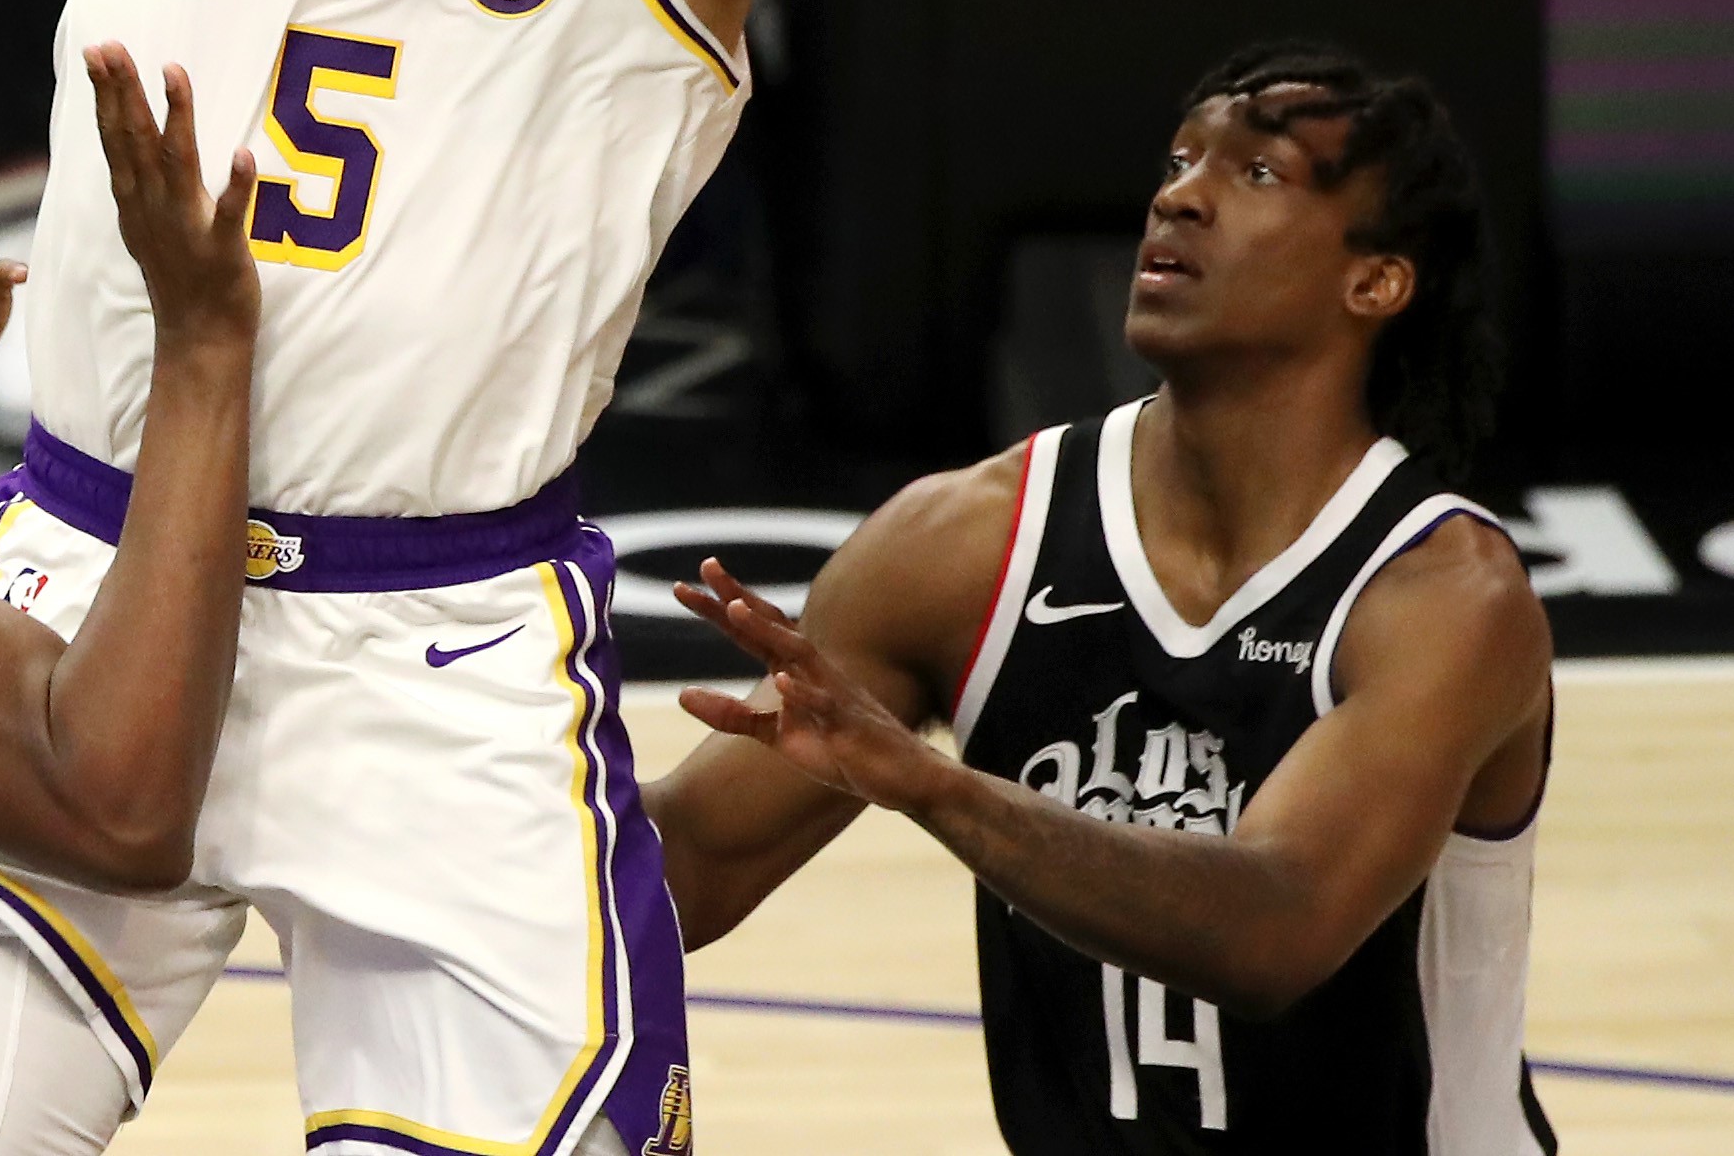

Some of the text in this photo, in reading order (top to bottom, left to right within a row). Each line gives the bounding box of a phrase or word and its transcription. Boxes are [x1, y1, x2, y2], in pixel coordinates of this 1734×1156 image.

[248, 22, 404, 273] 5
[1238, 626, 1315, 675] honey
[1077, 691, 1230, 815] Los
[1101, 961, 1229, 1131] 14
